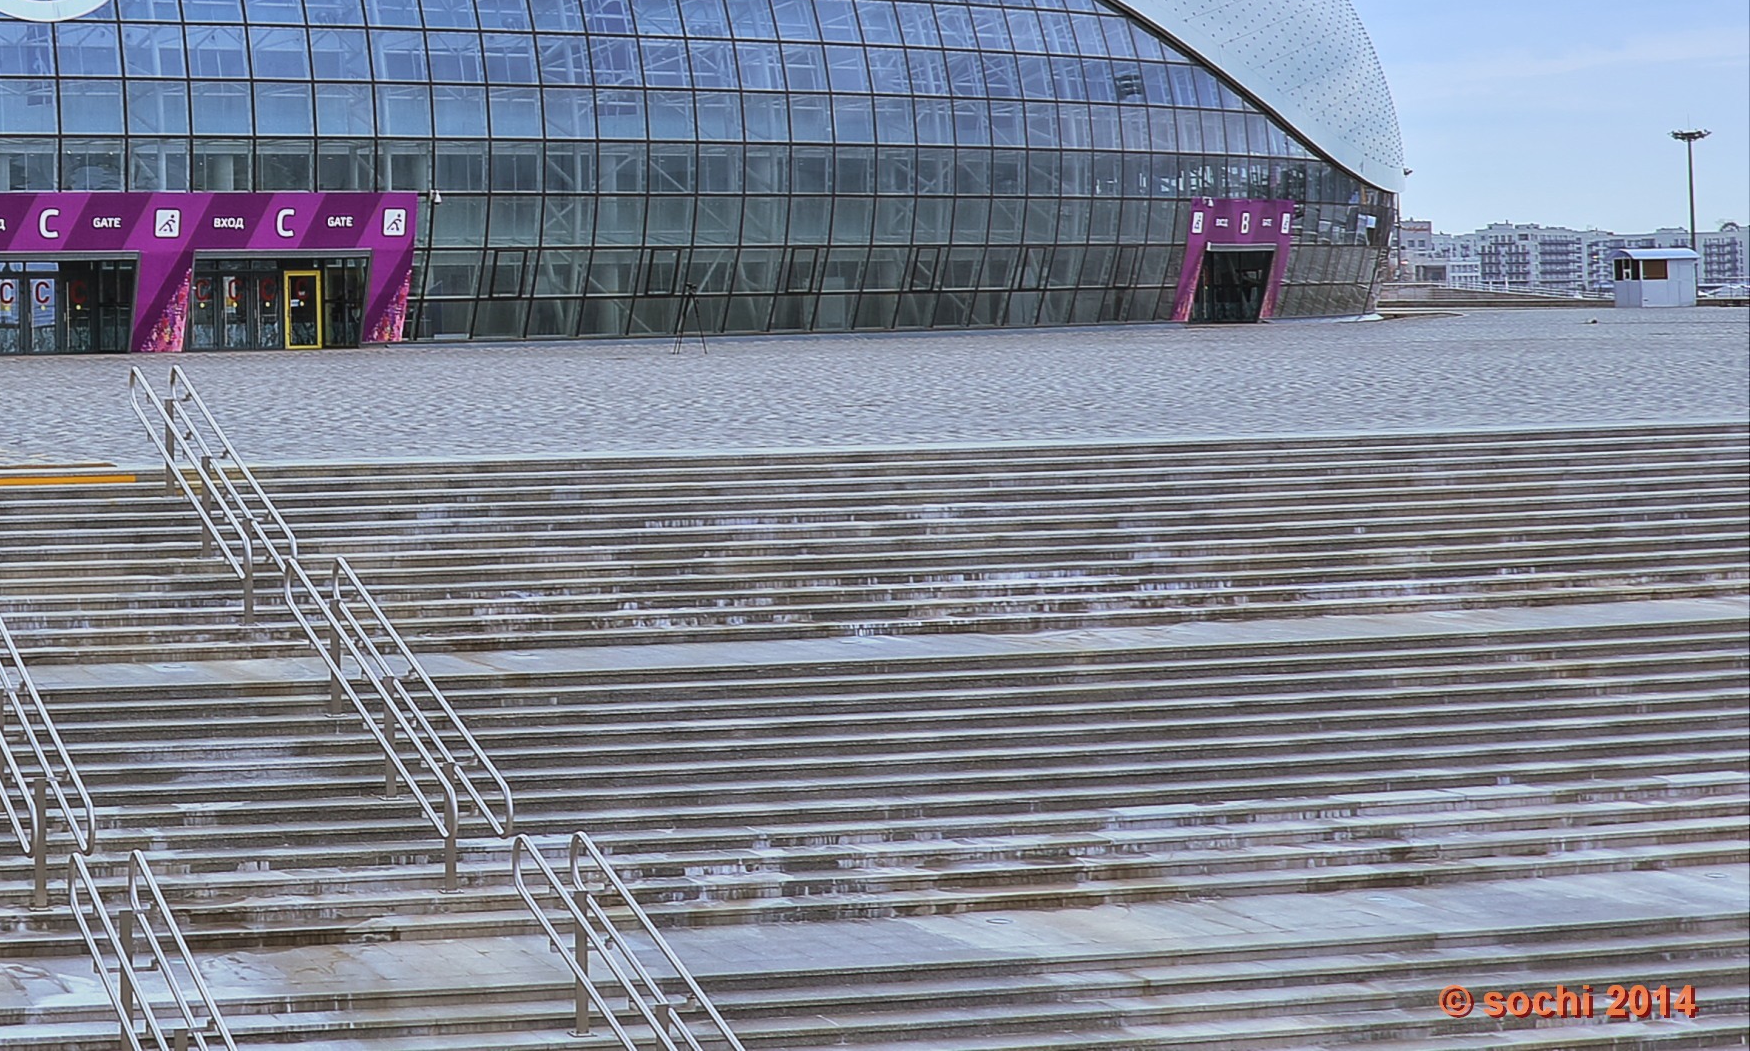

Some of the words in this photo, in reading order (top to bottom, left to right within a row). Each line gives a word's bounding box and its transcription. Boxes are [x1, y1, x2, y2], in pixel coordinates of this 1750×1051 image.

[39, 208, 60, 238] C
[93, 217, 122, 228] GATE
[213, 217, 245, 230] ВХОД
[276, 208, 295, 237] C
[327, 216, 354, 227] GATE
[0, 282, 14, 304] C
[35, 281, 50, 303] C
